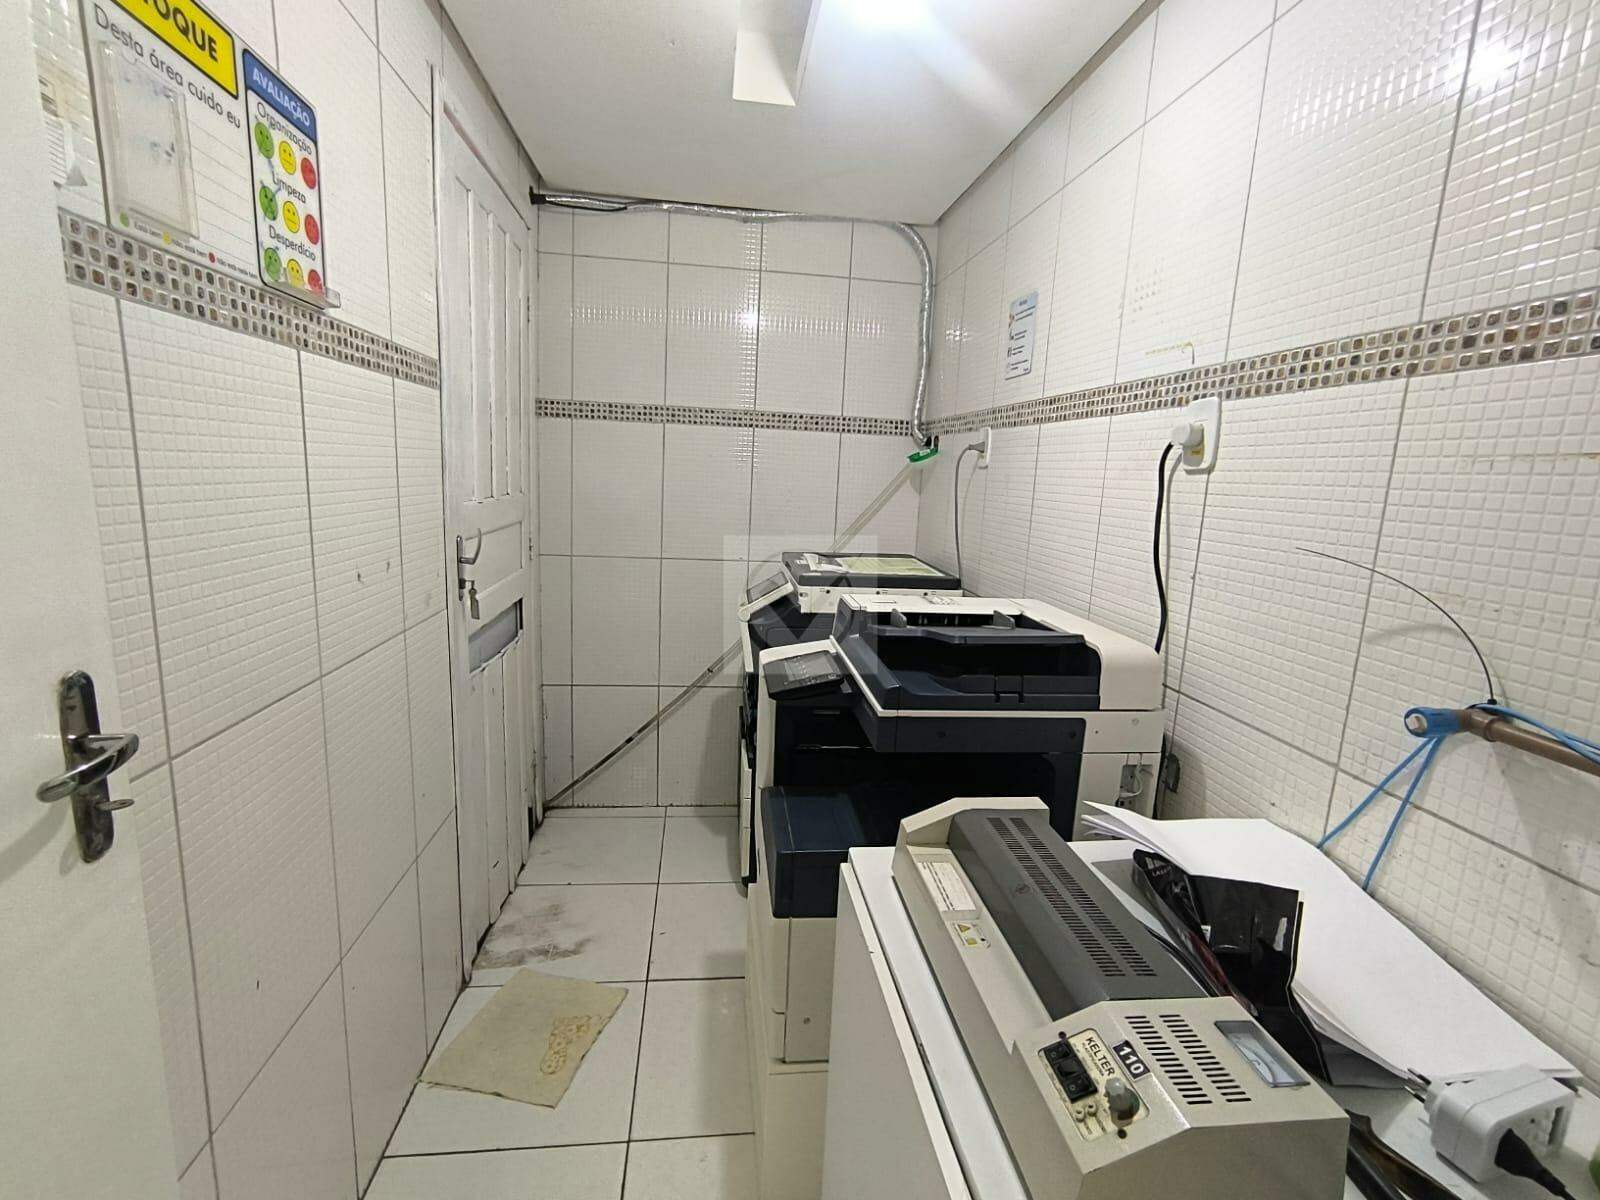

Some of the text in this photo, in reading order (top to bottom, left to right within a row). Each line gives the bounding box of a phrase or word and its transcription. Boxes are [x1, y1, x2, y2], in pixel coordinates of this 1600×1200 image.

[143, 0, 218, 62] OQUE
[94, 2, 144, 57] Desta
[149, 48, 183, 87] área
[187, 82, 223, 115] cuido
[226, 111, 240, 128] eu
[253, 67, 310, 127] AVALIAÇÃO
[257, 102, 312, 155] Organização
[1085, 1036, 1116, 1077] KELTER
[1119, 1045, 1145, 1074] 110
